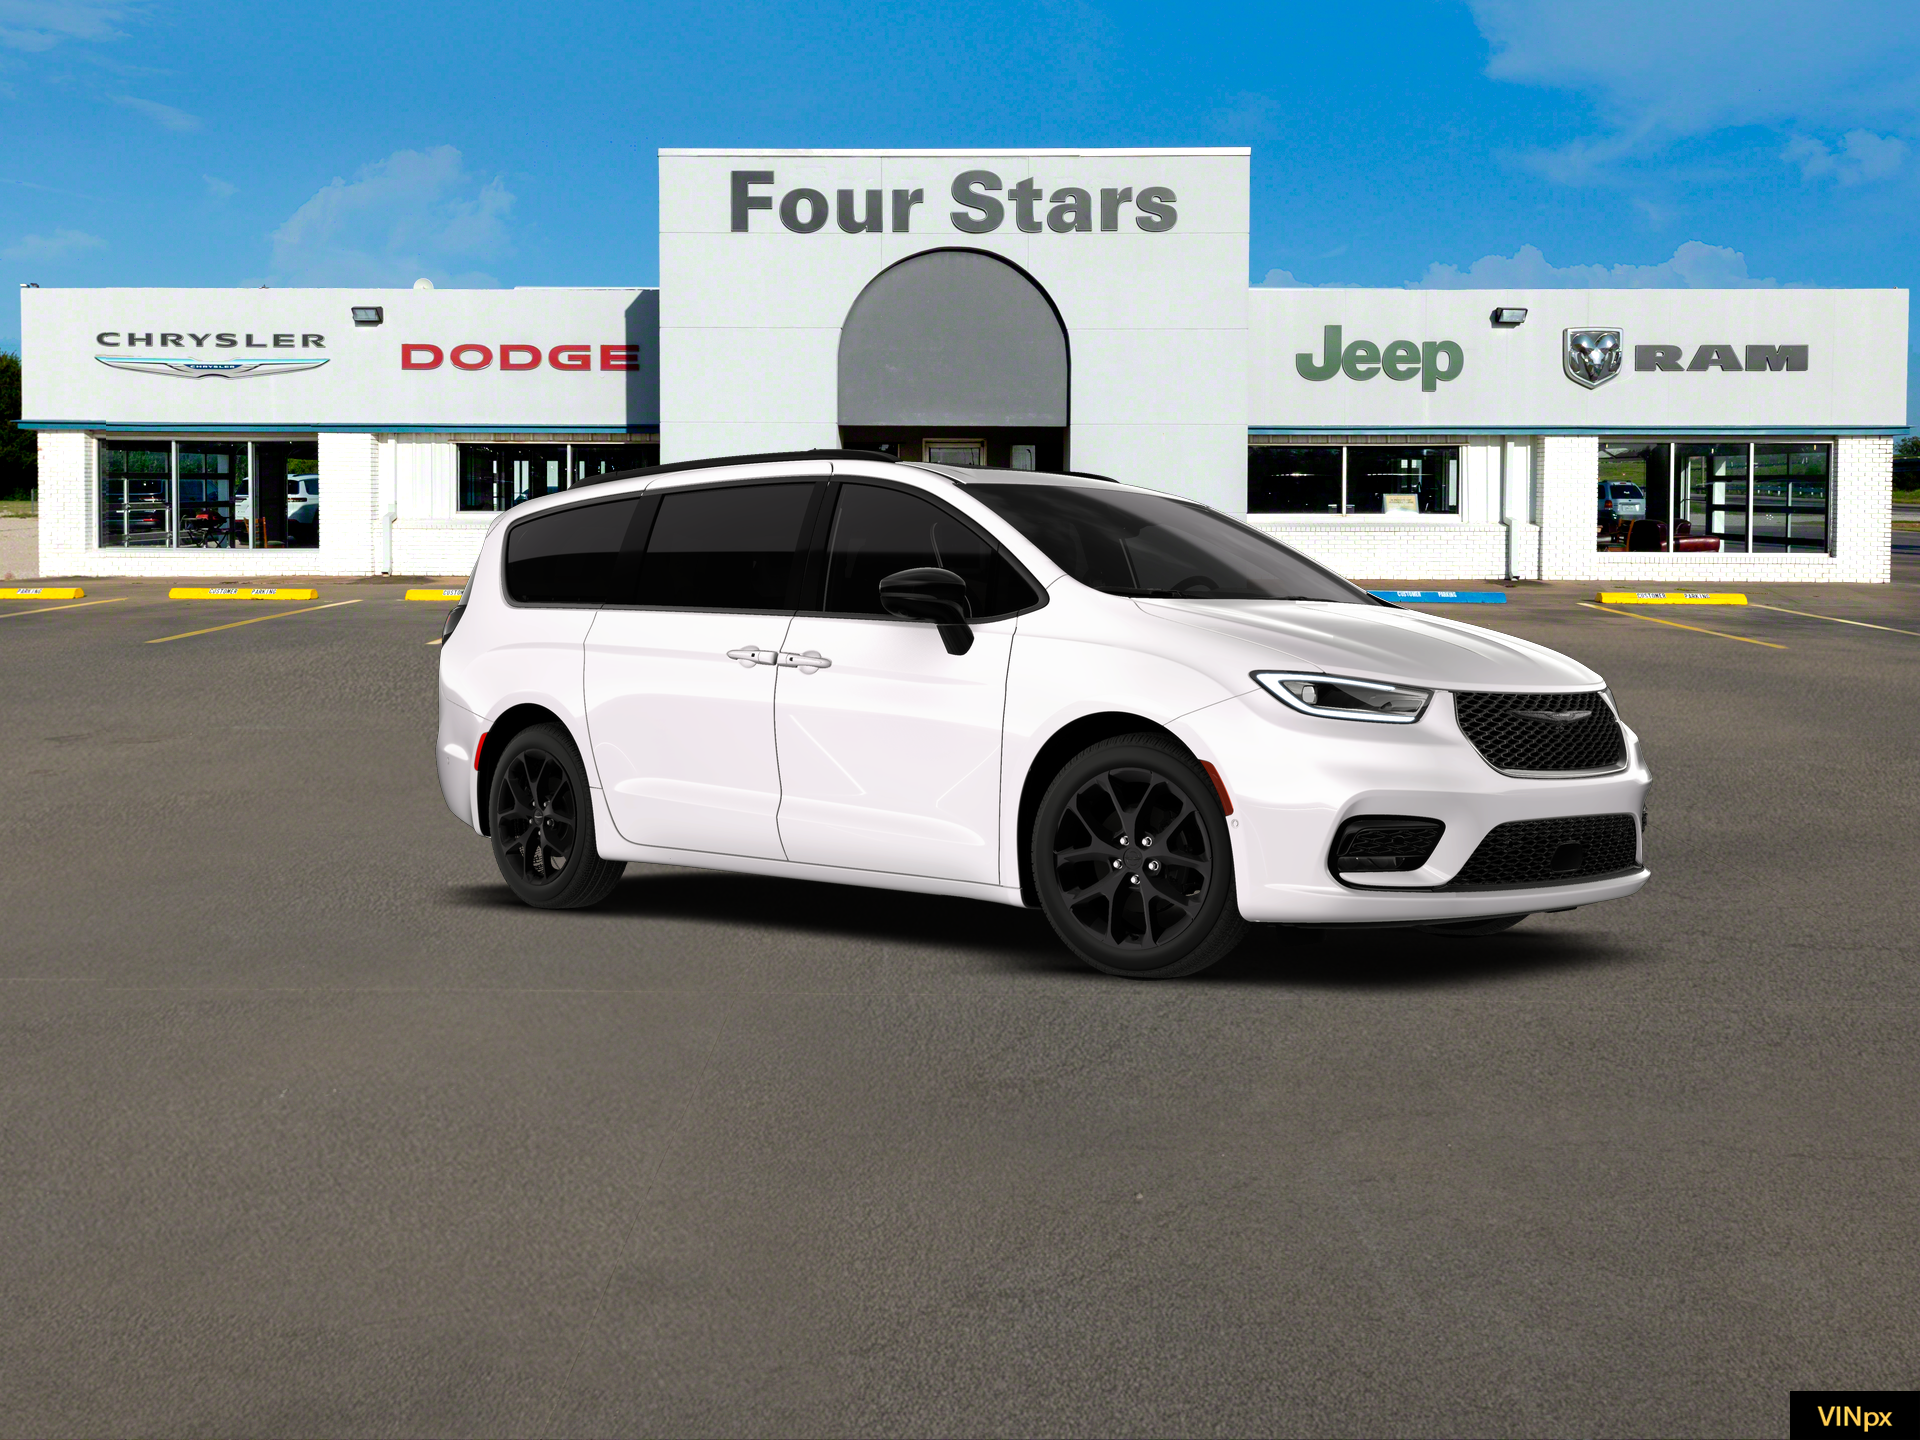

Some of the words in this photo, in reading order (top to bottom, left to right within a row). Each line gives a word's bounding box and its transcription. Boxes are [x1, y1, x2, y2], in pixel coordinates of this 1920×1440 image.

[730, 170, 924, 234] Four
[949, 169, 1178, 234] Stars
[96, 332, 327, 348] CHRYSLER
[401, 343, 641, 371] DODGE
[1295, 325, 1464, 392] Jeep
[1634, 344, 1809, 372] RAM
